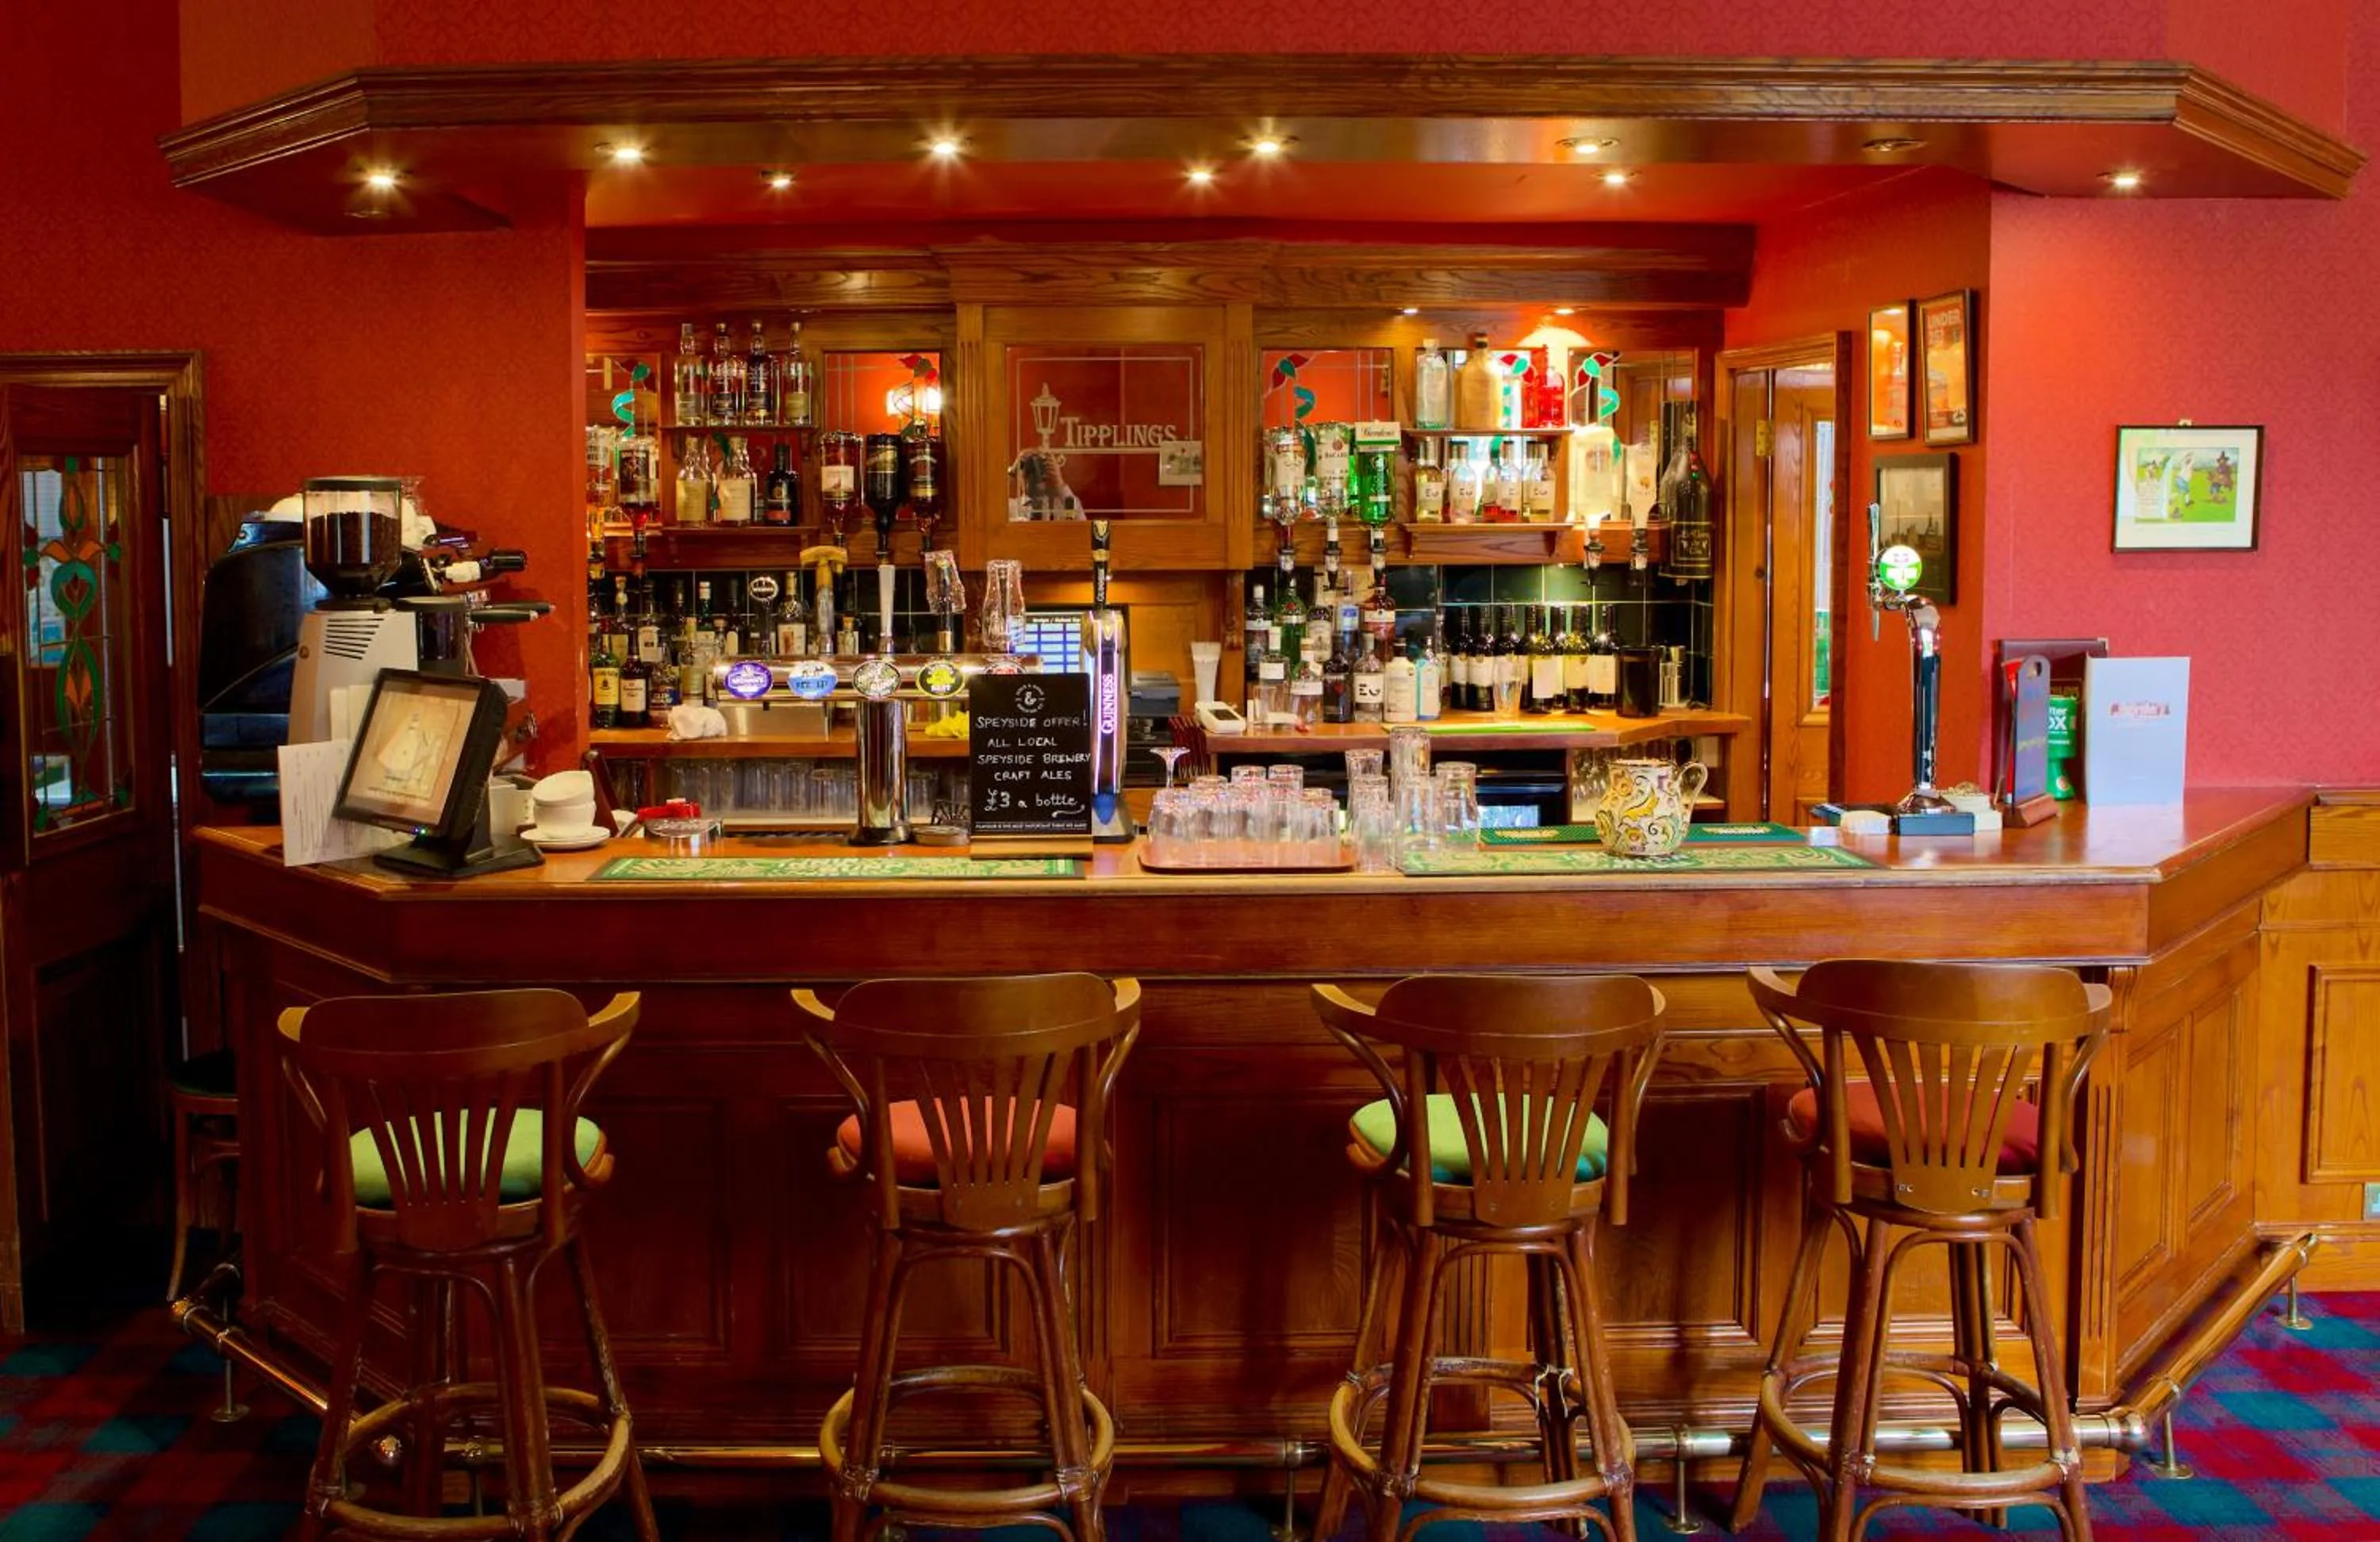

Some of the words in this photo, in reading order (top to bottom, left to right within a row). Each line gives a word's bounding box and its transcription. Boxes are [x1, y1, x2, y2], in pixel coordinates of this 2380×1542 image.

[1060, 416, 1177, 447] TIPPLINGS
[1101, 673, 1114, 734] GUINNESS
[975, 716, 1037, 729] SPEYSIDE
[987, 738, 1010, 748] ALL
[1018, 738, 1058, 747] LOCAL
[977, 754, 1034, 765] SPEYSIDE
[1042, 754, 1091, 764] BREWERY
[994, 771, 1031, 781] CRAFT
[1041, 770, 1072, 781] ALES
[984, 788, 1011, 811] £3
[1035, 793, 1077, 807] bottle
